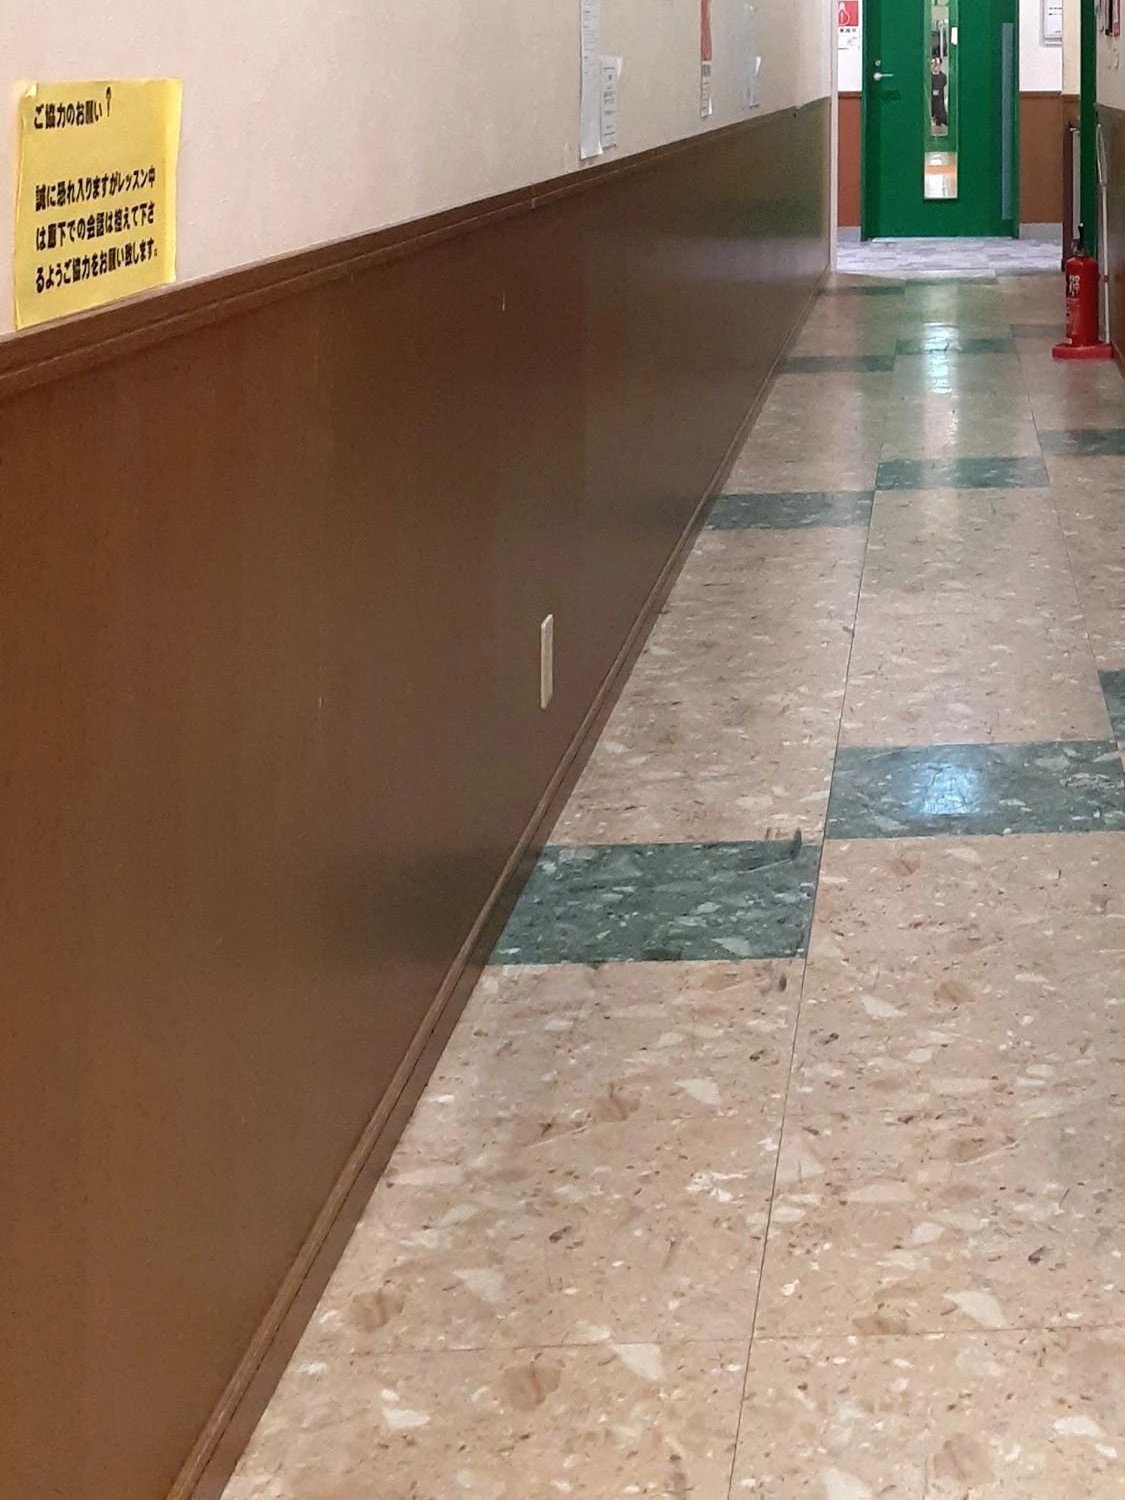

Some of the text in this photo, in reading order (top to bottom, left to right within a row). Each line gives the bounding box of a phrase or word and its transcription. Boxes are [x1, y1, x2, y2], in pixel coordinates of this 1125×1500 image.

[36, 165, 156, 212] 誠に恐れ入りますがレッスン中
[36, 201, 155, 251] は廊下での会話は控えて下さ
[36, 237, 158, 293] るようご協力をお願い致します。
